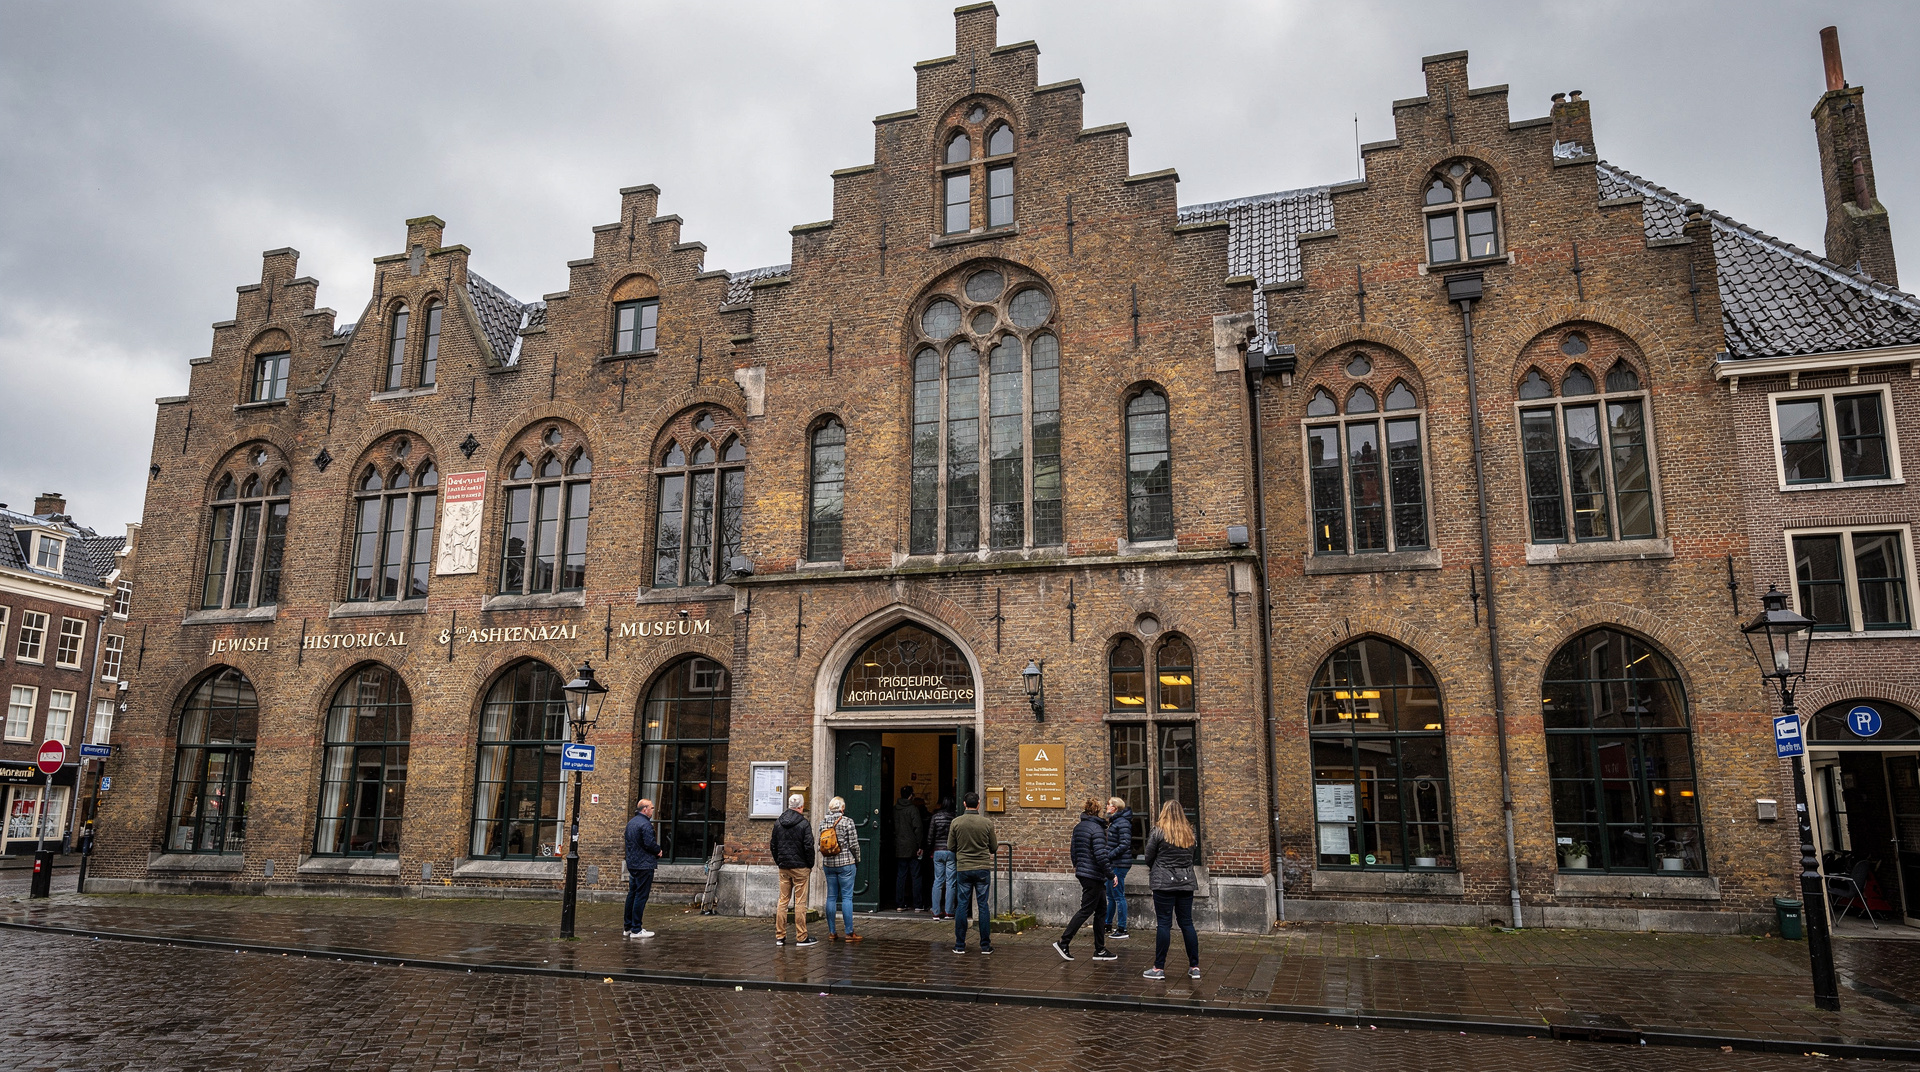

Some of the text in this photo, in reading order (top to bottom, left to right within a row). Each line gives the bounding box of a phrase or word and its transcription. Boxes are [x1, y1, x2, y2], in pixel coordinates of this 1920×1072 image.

[209, 637, 269, 656] JEWISH
[302, 631, 408, 650] HISTORICAL
[439, 628, 451, 645] &
[618, 619, 711, 638] MUSEUM
